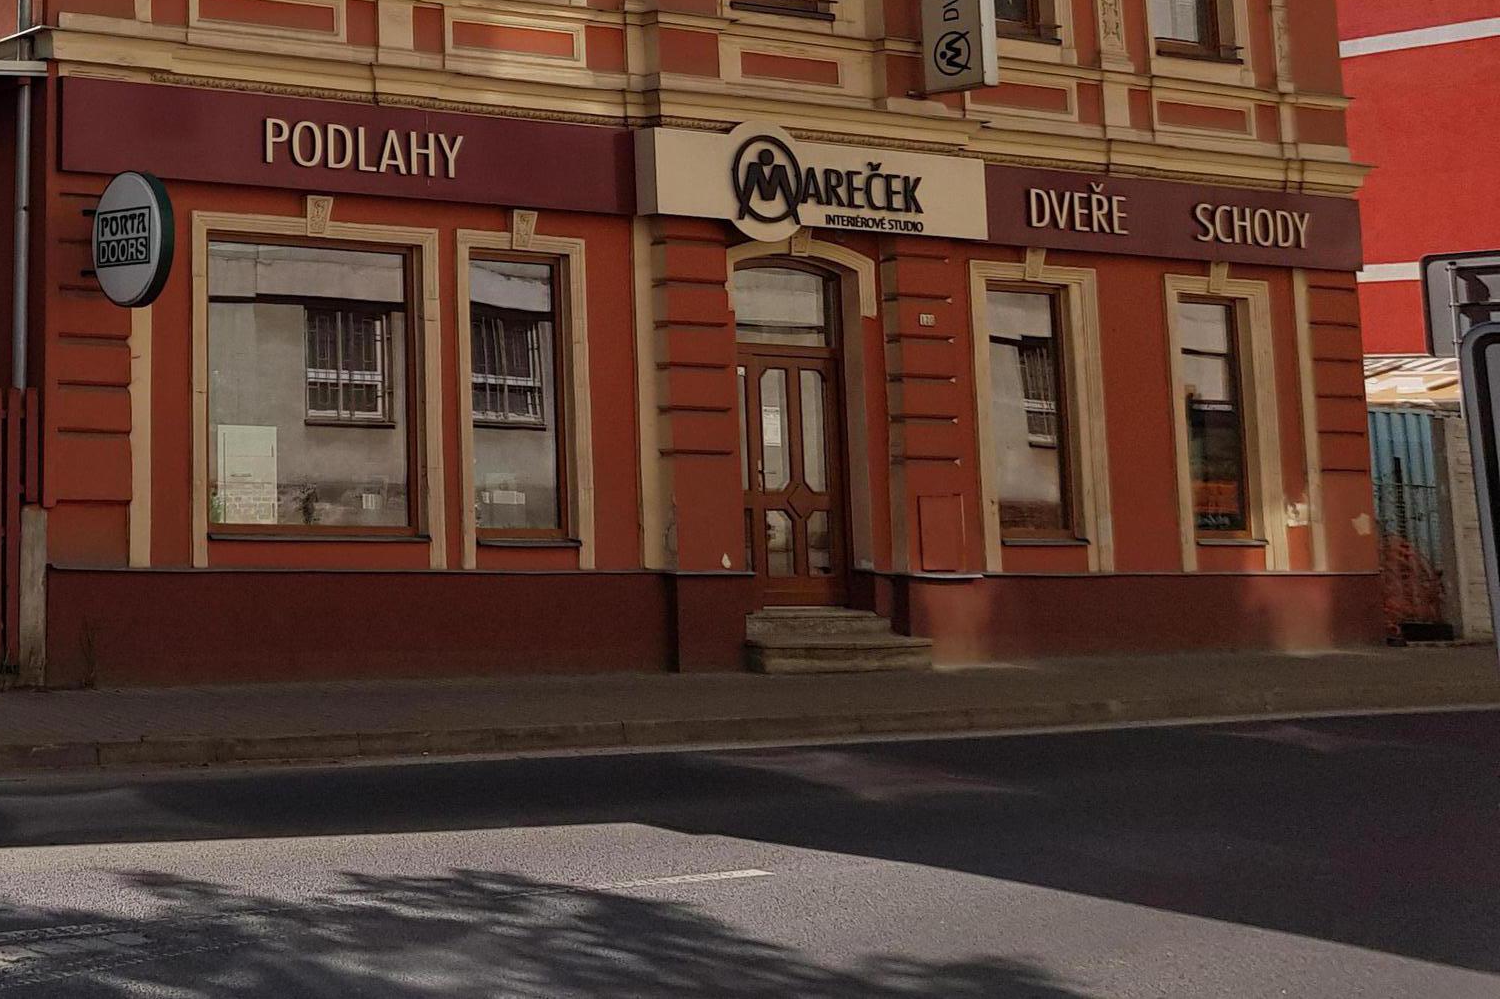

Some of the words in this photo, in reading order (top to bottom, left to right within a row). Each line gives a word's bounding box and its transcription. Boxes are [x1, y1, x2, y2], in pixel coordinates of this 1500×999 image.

[264, 117, 464, 178] PODLAHY
[732, 135, 924, 225] MAREČEK
[100, 212, 146, 237] PORTA
[825, 214, 886, 229] INTERIÉROVÉ
[888, 220, 924, 232] STUDIO
[1028, 182, 1130, 235] DVEŘE
[1195, 202, 1310, 249] SCHODY
[100, 238, 146, 262] DOORS
